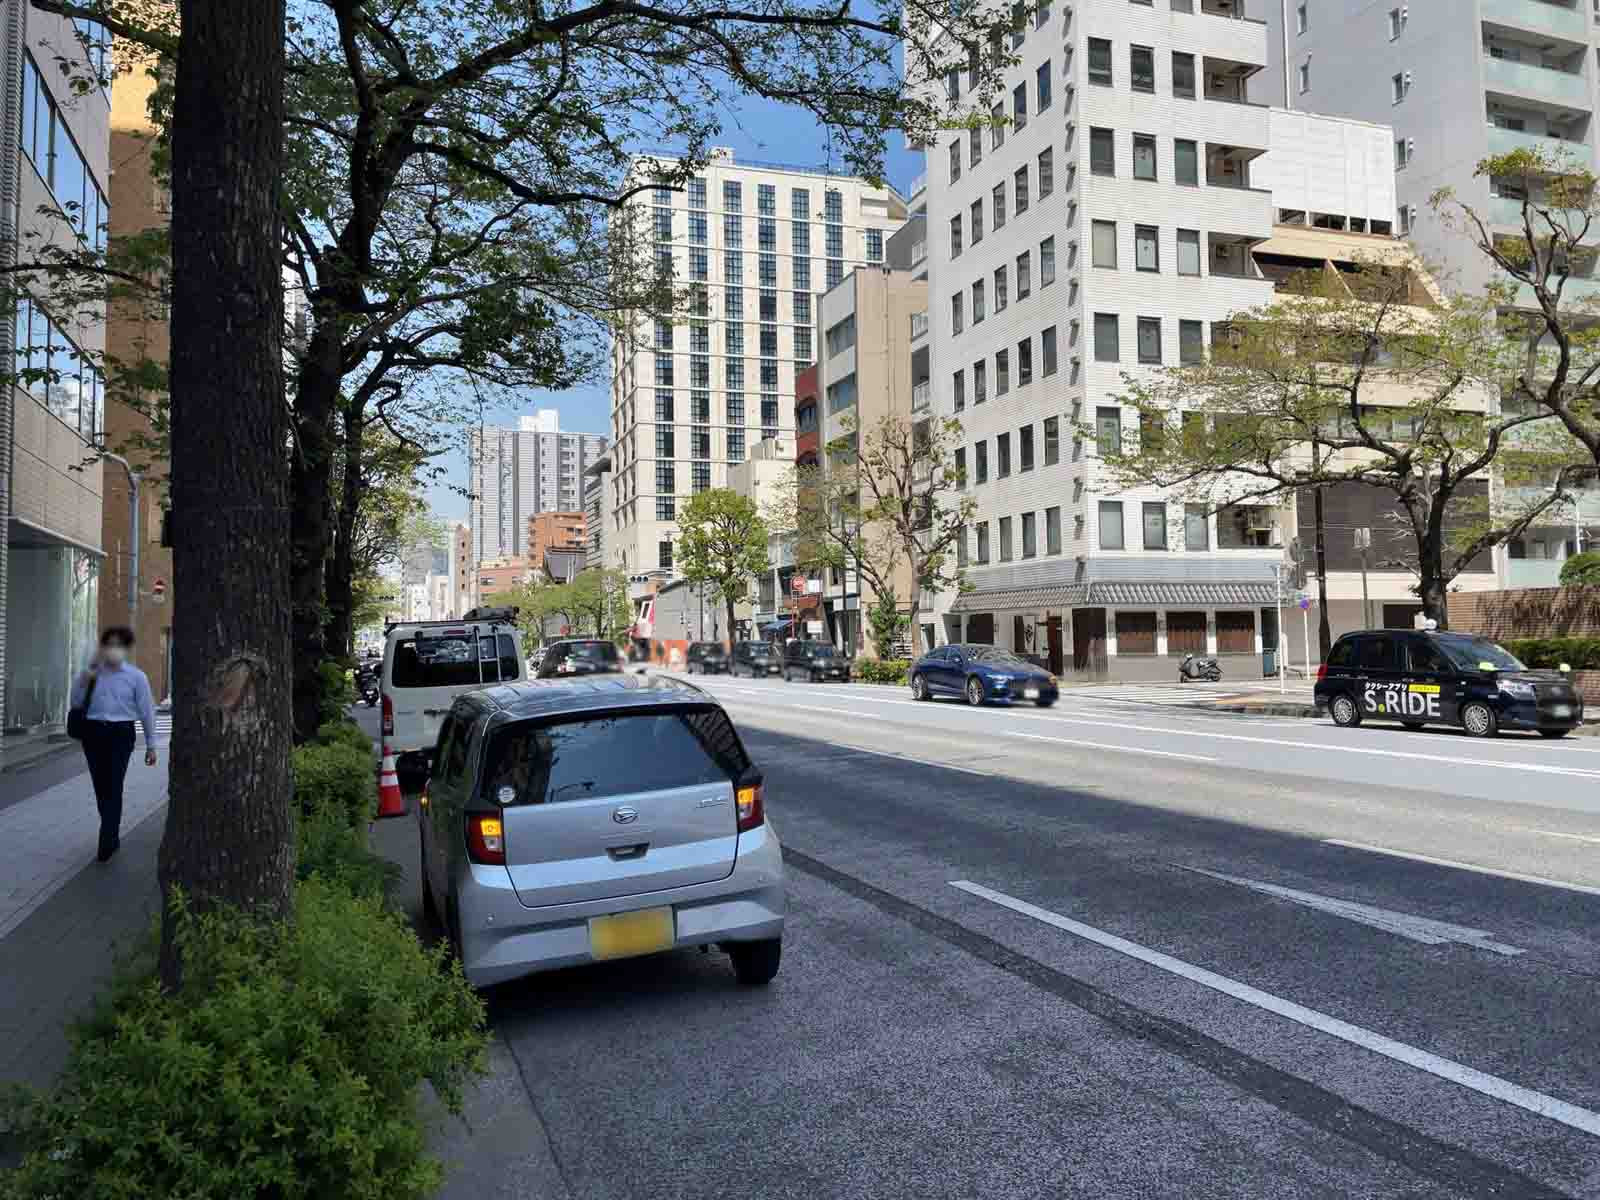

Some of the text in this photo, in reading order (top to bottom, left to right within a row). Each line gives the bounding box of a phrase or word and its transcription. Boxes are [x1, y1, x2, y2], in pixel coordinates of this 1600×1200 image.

[1365, 681, 1408, 691] タクシーアプリ
[1364, 689, 1440, 717] S.RIDE
